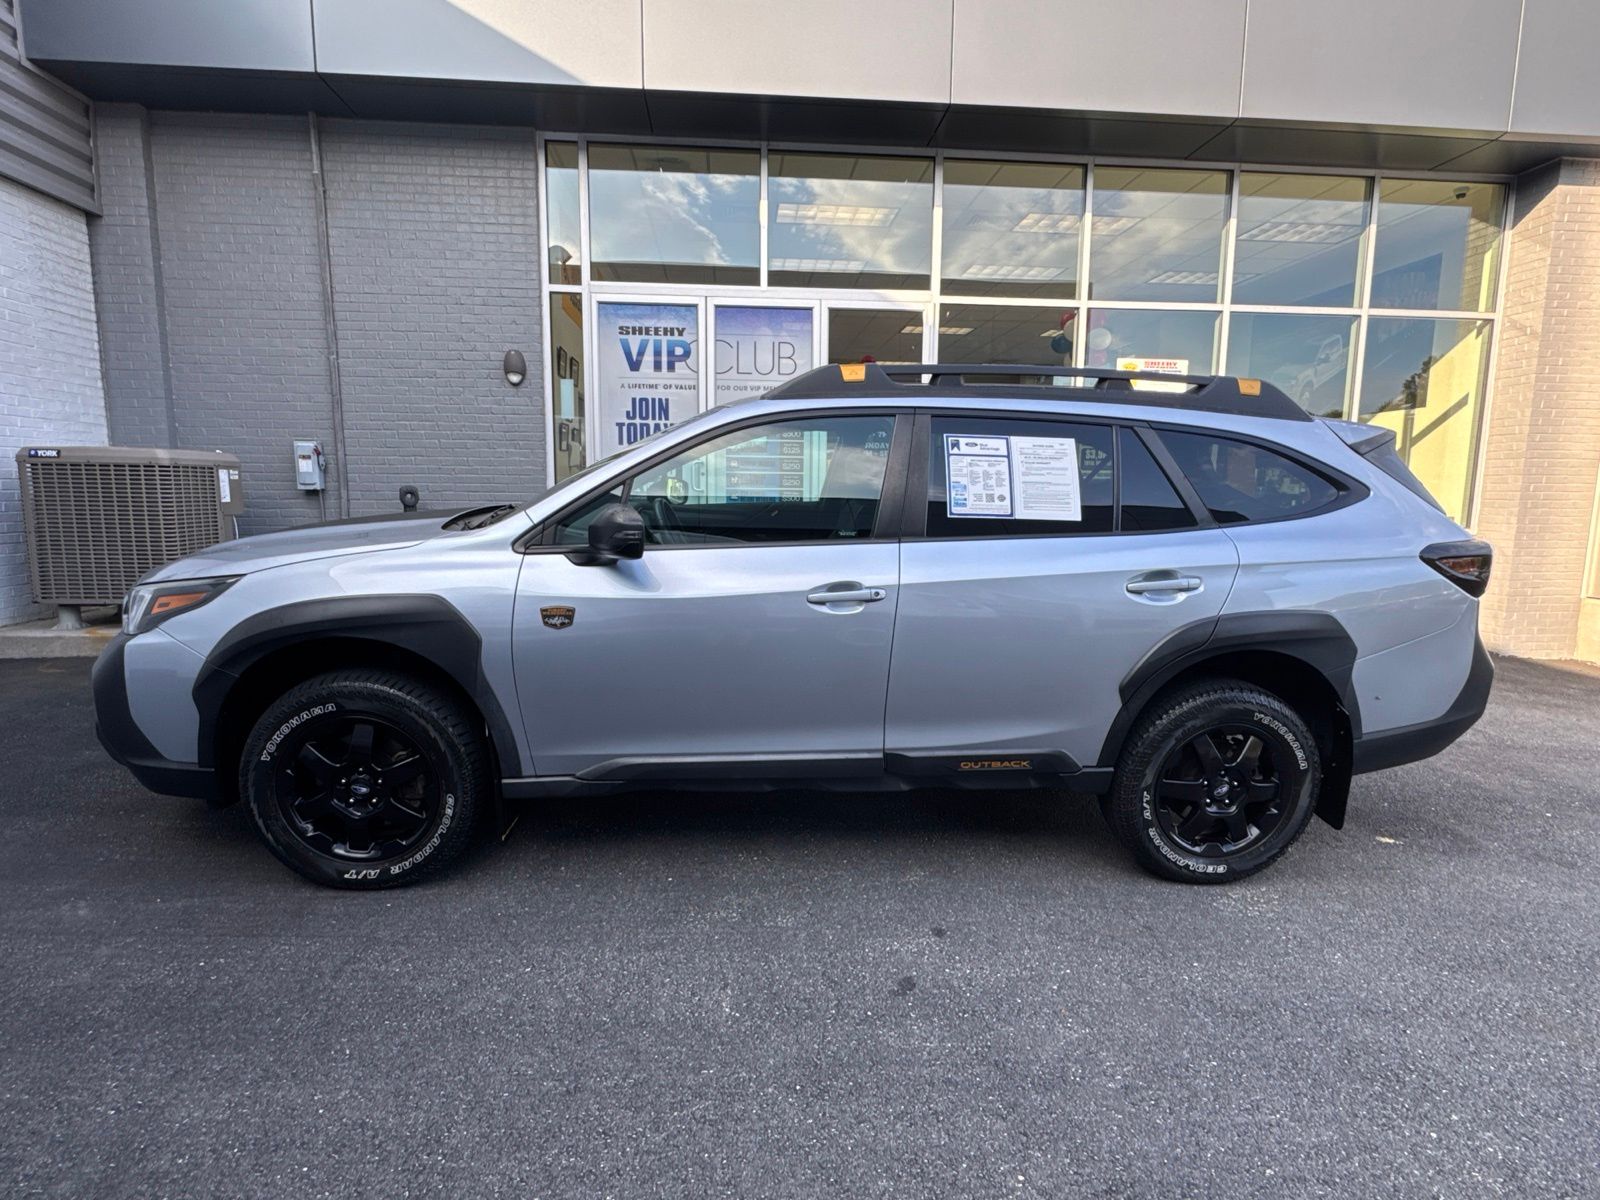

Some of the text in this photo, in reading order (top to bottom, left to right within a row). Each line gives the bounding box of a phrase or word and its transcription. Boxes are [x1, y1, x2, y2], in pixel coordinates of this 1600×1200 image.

[618, 325, 687, 337] SHEEHY
[619, 338, 797, 376] VIP CLUB
[625, 397, 670, 421] JOIN
[615, 422, 675, 446] TOD
[260, 702, 337, 763] YOKOHAMA
[1253, 711, 1309, 771] YOKOHAMA
[960, 760, 1031, 769] OUTBACK
[343, 792, 456, 880] GEOLANDAR A/T
[1148, 826, 1228, 875] GEOLANDAR
